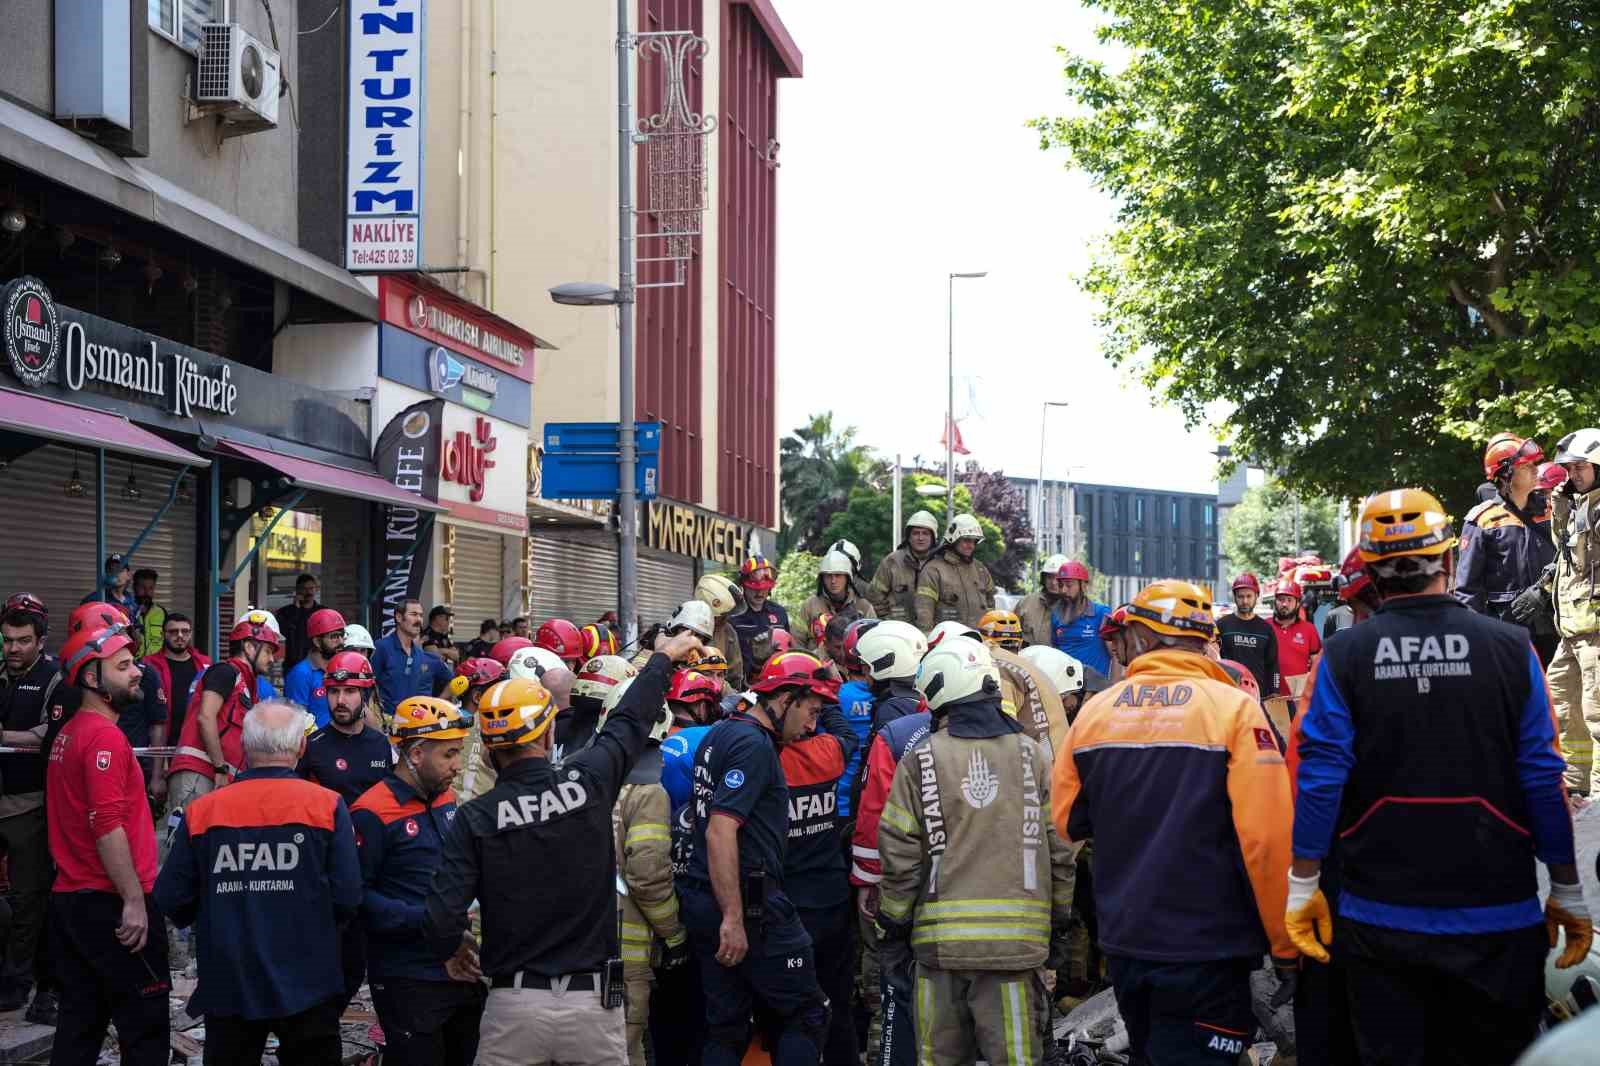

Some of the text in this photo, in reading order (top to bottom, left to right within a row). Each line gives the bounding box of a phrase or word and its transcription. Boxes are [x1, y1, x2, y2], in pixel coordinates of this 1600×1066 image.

[352, 219, 414, 243] NAKLİYE
[352, 249, 414, 265] Tel:425 02 39
[14, 315, 50, 343] Osmanlı
[428, 304, 525, 368] TURKISH AIRLINES
[66, 321, 237, 418] Osmanlı Künefe
[386, 446, 424, 541] KÜEFE
[648, 499, 744, 567] MARRAKECH
[1374, 633, 1470, 664] AFAD
[1375, 664, 1407, 680] ARAMA
[1408, 663, 1420, 677] VE
[852, 701, 873, 716] AF
[1113, 684, 1193, 707] AFAD
[497, 780, 587, 830] AFAD
[914, 742, 946, 855] İSTANBUL
[213, 842, 299, 874] AFAD
[216, 880, 243, 894] ARAMA
[249, 879, 294, 892] KURTARMA
[1208, 1035, 1242, 1054] AFAD
